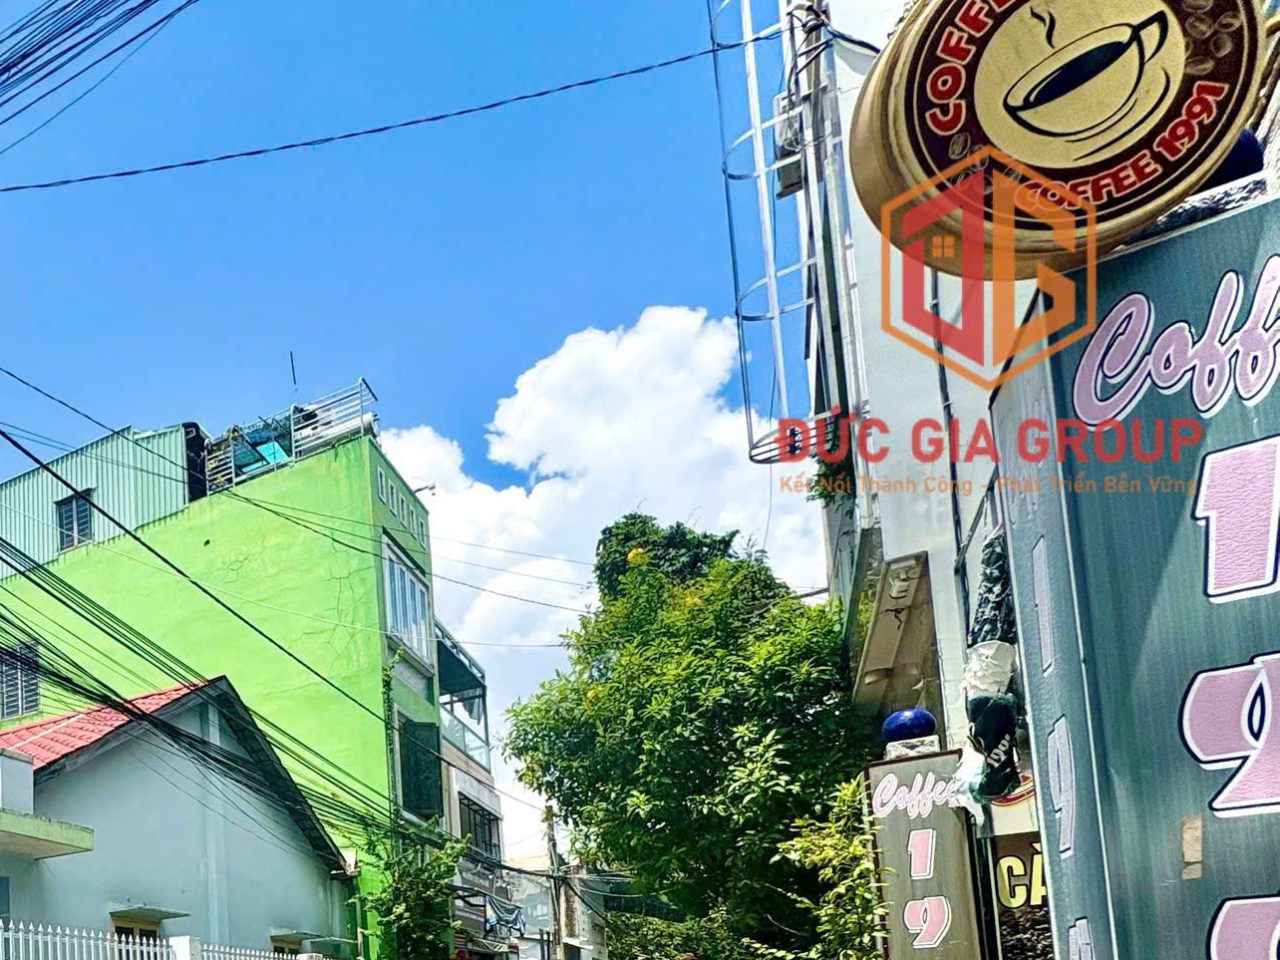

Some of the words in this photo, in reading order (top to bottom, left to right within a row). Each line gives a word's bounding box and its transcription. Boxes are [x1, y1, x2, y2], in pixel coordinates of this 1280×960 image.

[925, 0, 1017, 136] COFF
[1015, 149, 1163, 211] COFFEE
[1153, 80, 1229, 161] 1991
